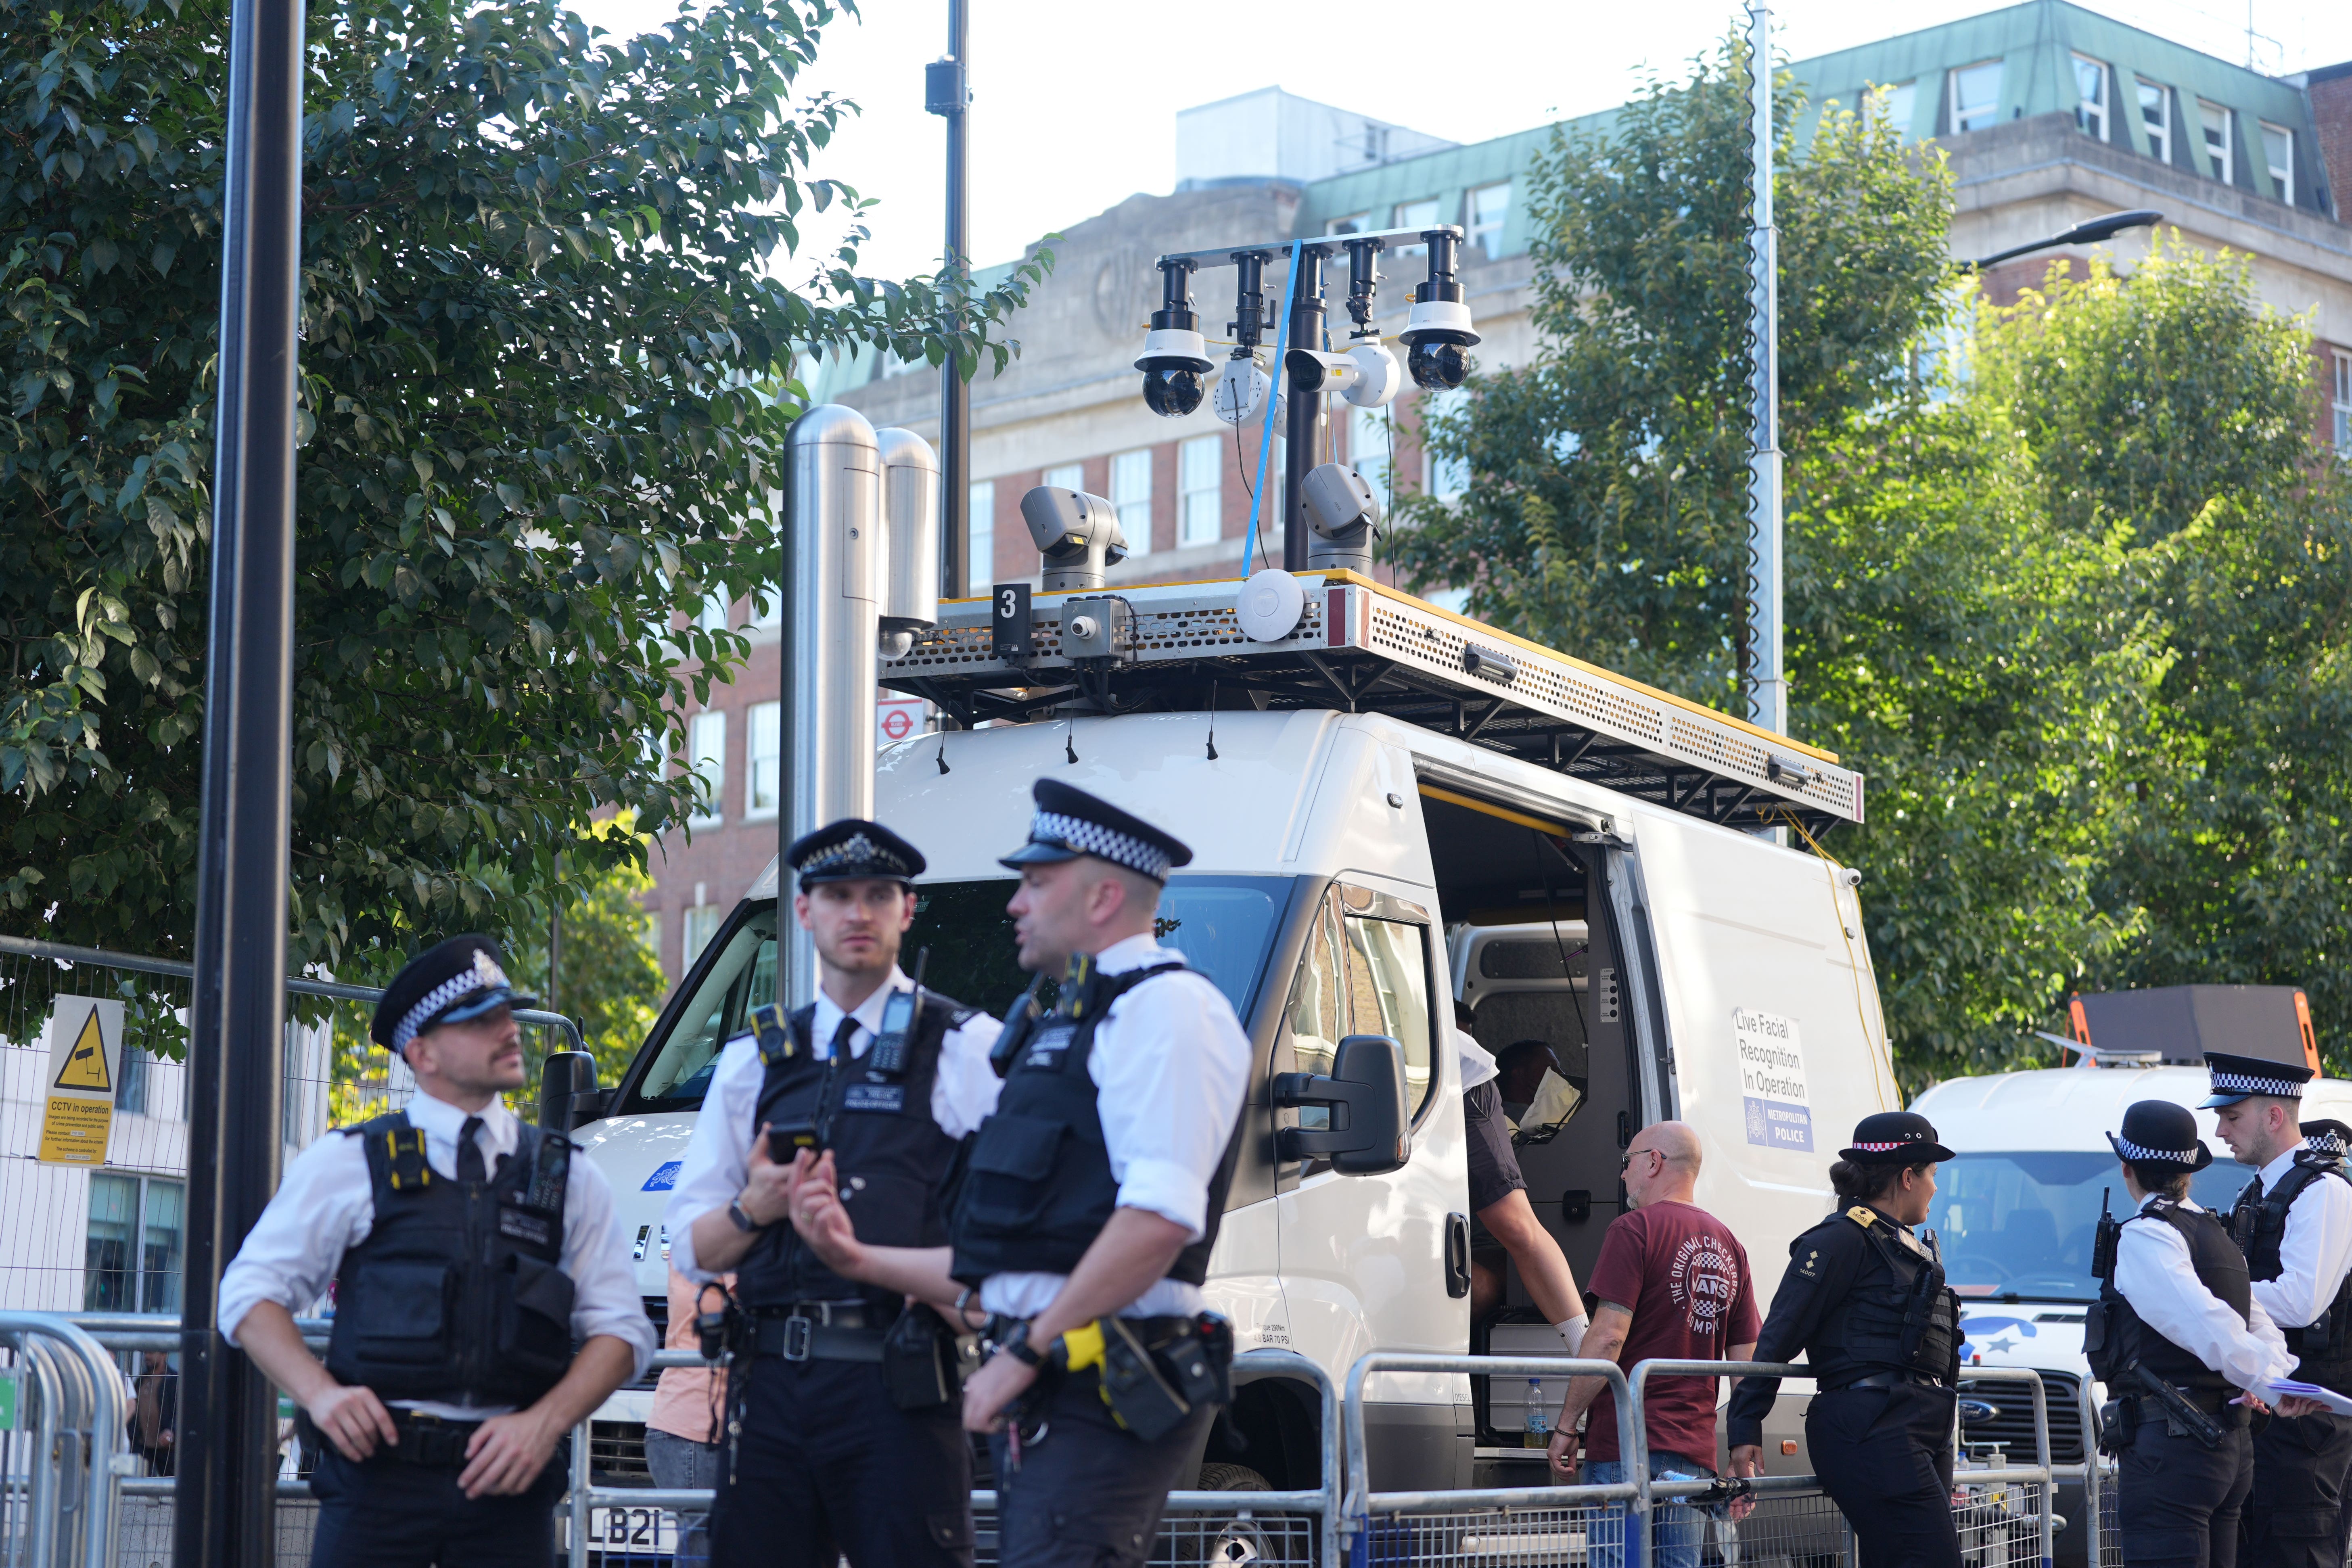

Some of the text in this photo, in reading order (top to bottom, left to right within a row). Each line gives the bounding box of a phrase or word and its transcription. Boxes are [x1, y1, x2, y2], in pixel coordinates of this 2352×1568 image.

[1001, 589, 1016, 618] 3
[1735, 1010, 1789, 1039] Live Facial
[1739, 1038, 1800, 1070] Recognition
[1743, 1068, 1805, 1099] In Operation
[52, 1101, 109, 1114] CCTV in operation
[1768, 1109, 1808, 1125] METROPOLITAN
[1775, 1127, 1805, 1143] POLICE
[1670, 1236, 1738, 1311] THE ORIGINAL CHECKERBOAR
[1800, 1268, 1816, 1277] 14007
[1692, 1271, 1730, 1299] VANS
[1254, 1334, 1290, 1344] 4.8 BAR 70 PSI
[1455, 1393, 1471, 1402] DIESEL
